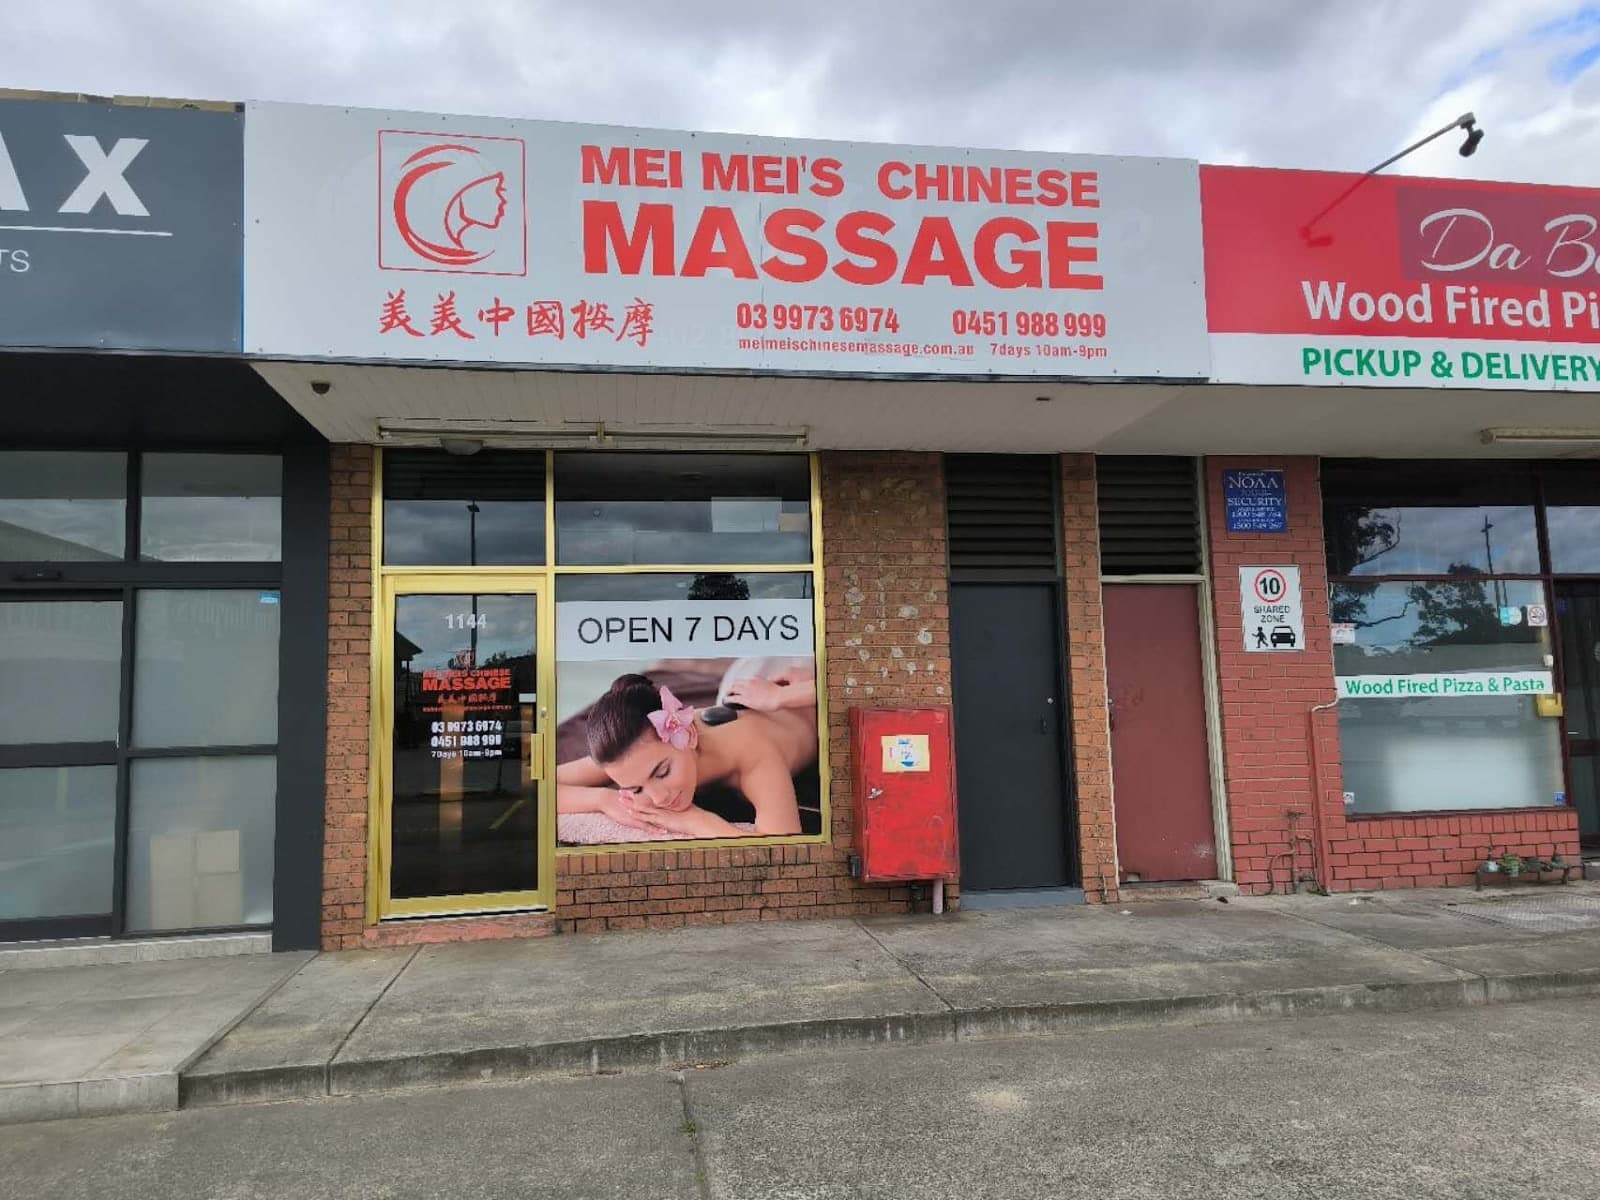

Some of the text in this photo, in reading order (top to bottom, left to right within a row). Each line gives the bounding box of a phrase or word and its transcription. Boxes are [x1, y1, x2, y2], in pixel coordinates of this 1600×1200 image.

[581, 145, 1101, 208] MEI MEI'S CHINESE
[583, 200, 1104, 289] MASSAGE
[1420, 208, 1600, 278] Da B
[379, 288, 655, 347] 美美中國按摩
[737, 302, 900, 334] 03 9973 6974
[1301, 280, 1433, 324] Wood
[1445, 284, 1551, 328] Fired
[952, 309, 1106, 338] 0451 988 999
[739, 337, 975, 357] meimeischinesemassage.com.au
[990, 343, 1108, 360] 7days 10am-9pm
[1302, 347, 1600, 382] PICKUP & DELIVERY
[1259, 577, 1281, 595] 10
[446, 613, 487, 630] 1144
[1253, 605, 1291, 614] SHARED
[1260, 614, 1286, 623] ZONE
[578, 614, 799, 644] OPEN 7 DAYS
[422, 677, 513, 691] MASSAGE
[1345, 676, 1546, 695] Wood Fired Pizza & Pasta
